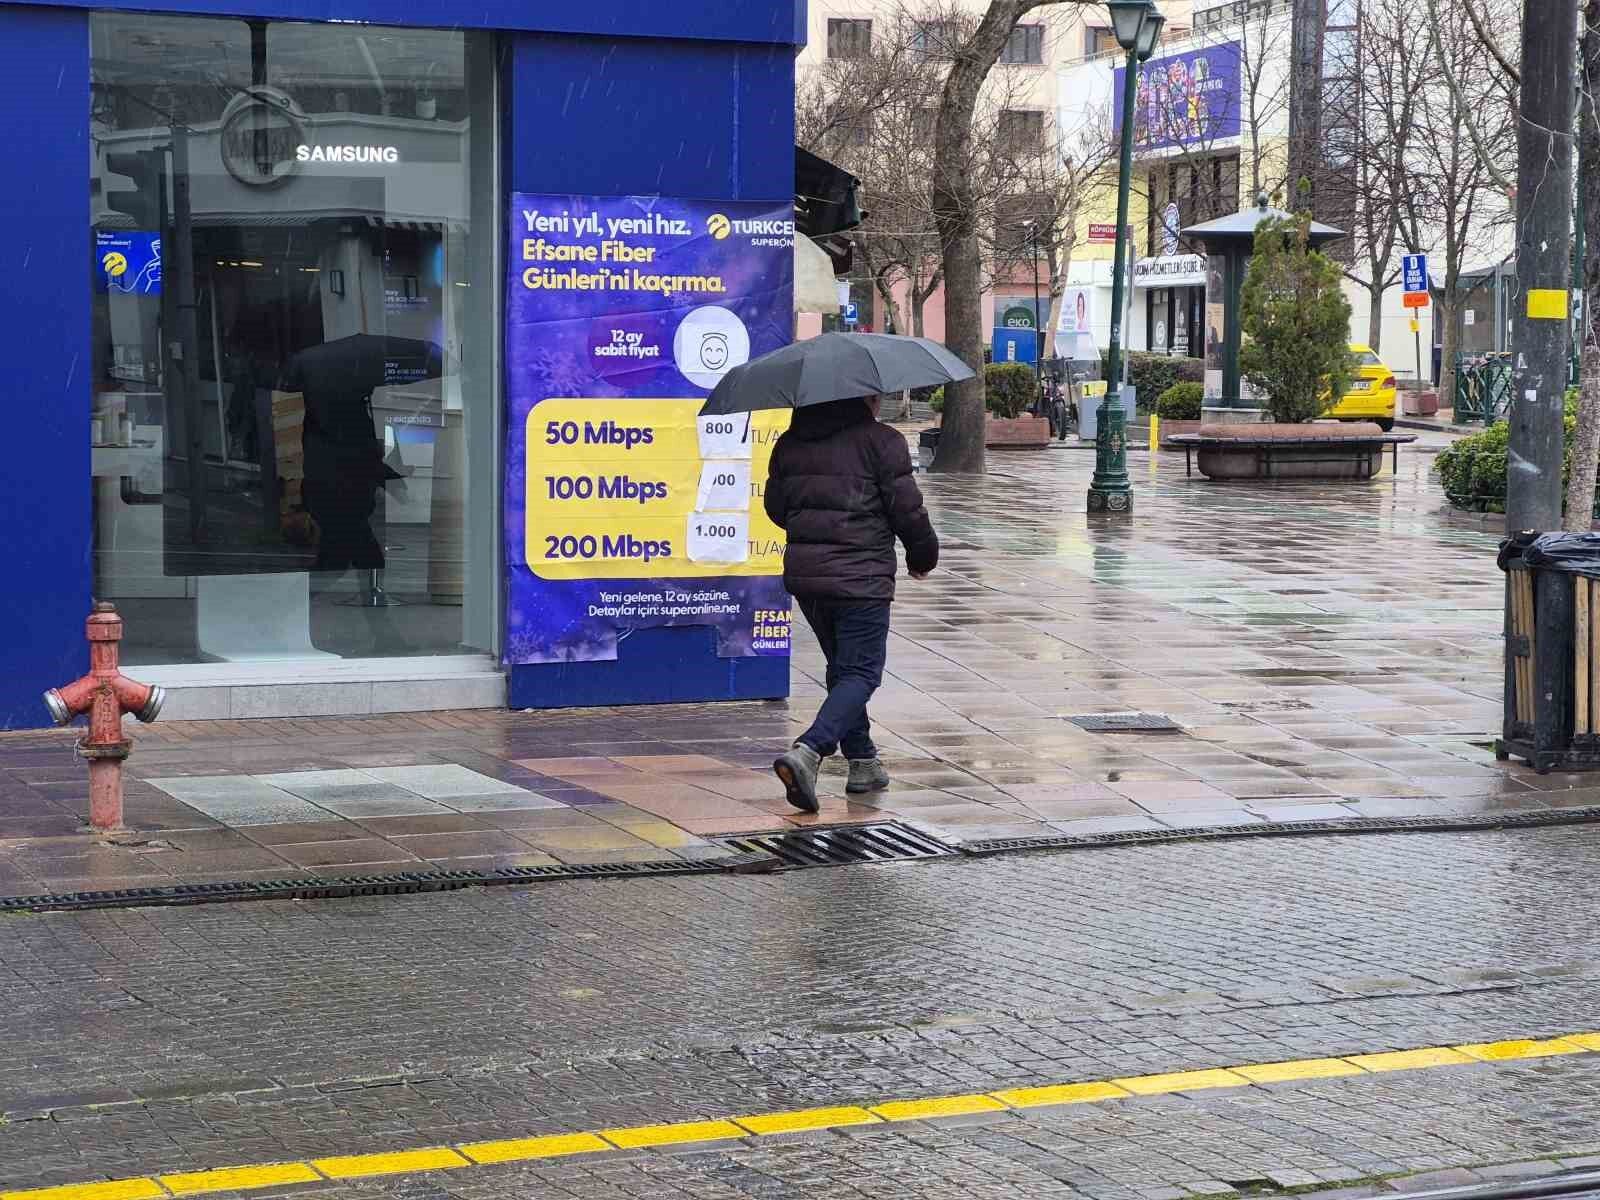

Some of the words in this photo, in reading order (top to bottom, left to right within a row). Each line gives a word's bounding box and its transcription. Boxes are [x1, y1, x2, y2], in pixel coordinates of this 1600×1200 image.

[296, 145, 398, 162] SAMSUNG
[523, 210, 568, 233] Yeni
[573, 211, 603, 238] yıl,
[607, 213, 652, 239] yeni
[656, 213, 692, 235] hız.
[522, 239, 597, 262] Efsane
[601, 240, 656, 262] Fiber
[1410, 256, 1417, 269] D
[633, 269, 727, 296] kaçırma.
[1007, 317, 1031, 327] eko
[610, 329, 625, 342] 12
[626, 332, 644, 346] ay
[595, 343, 627, 356] sabit
[628, 343, 660, 360] fiyat
[545, 421, 579, 445] 50
[584, 420, 654, 450] Mbps
[705, 422, 733, 434] 800
[751, 428, 781, 446] TL/A
[545, 475, 593, 500] 100
[598, 475, 668, 504] Mbps
[713, 473, 736, 486] 00
[545, 534, 597, 558] 200
[602, 534, 672, 562] Mbps
[695, 525, 736, 538] 1.000
[599, 591, 622, 603] Yeni
[665, 590, 675, 602] 12
[676, 592, 692, 604] ay
[588, 604, 637, 618] Detaylar
[660, 602, 741, 617] superonline.net
[752, 638, 789, 649] GÜNLERİ
